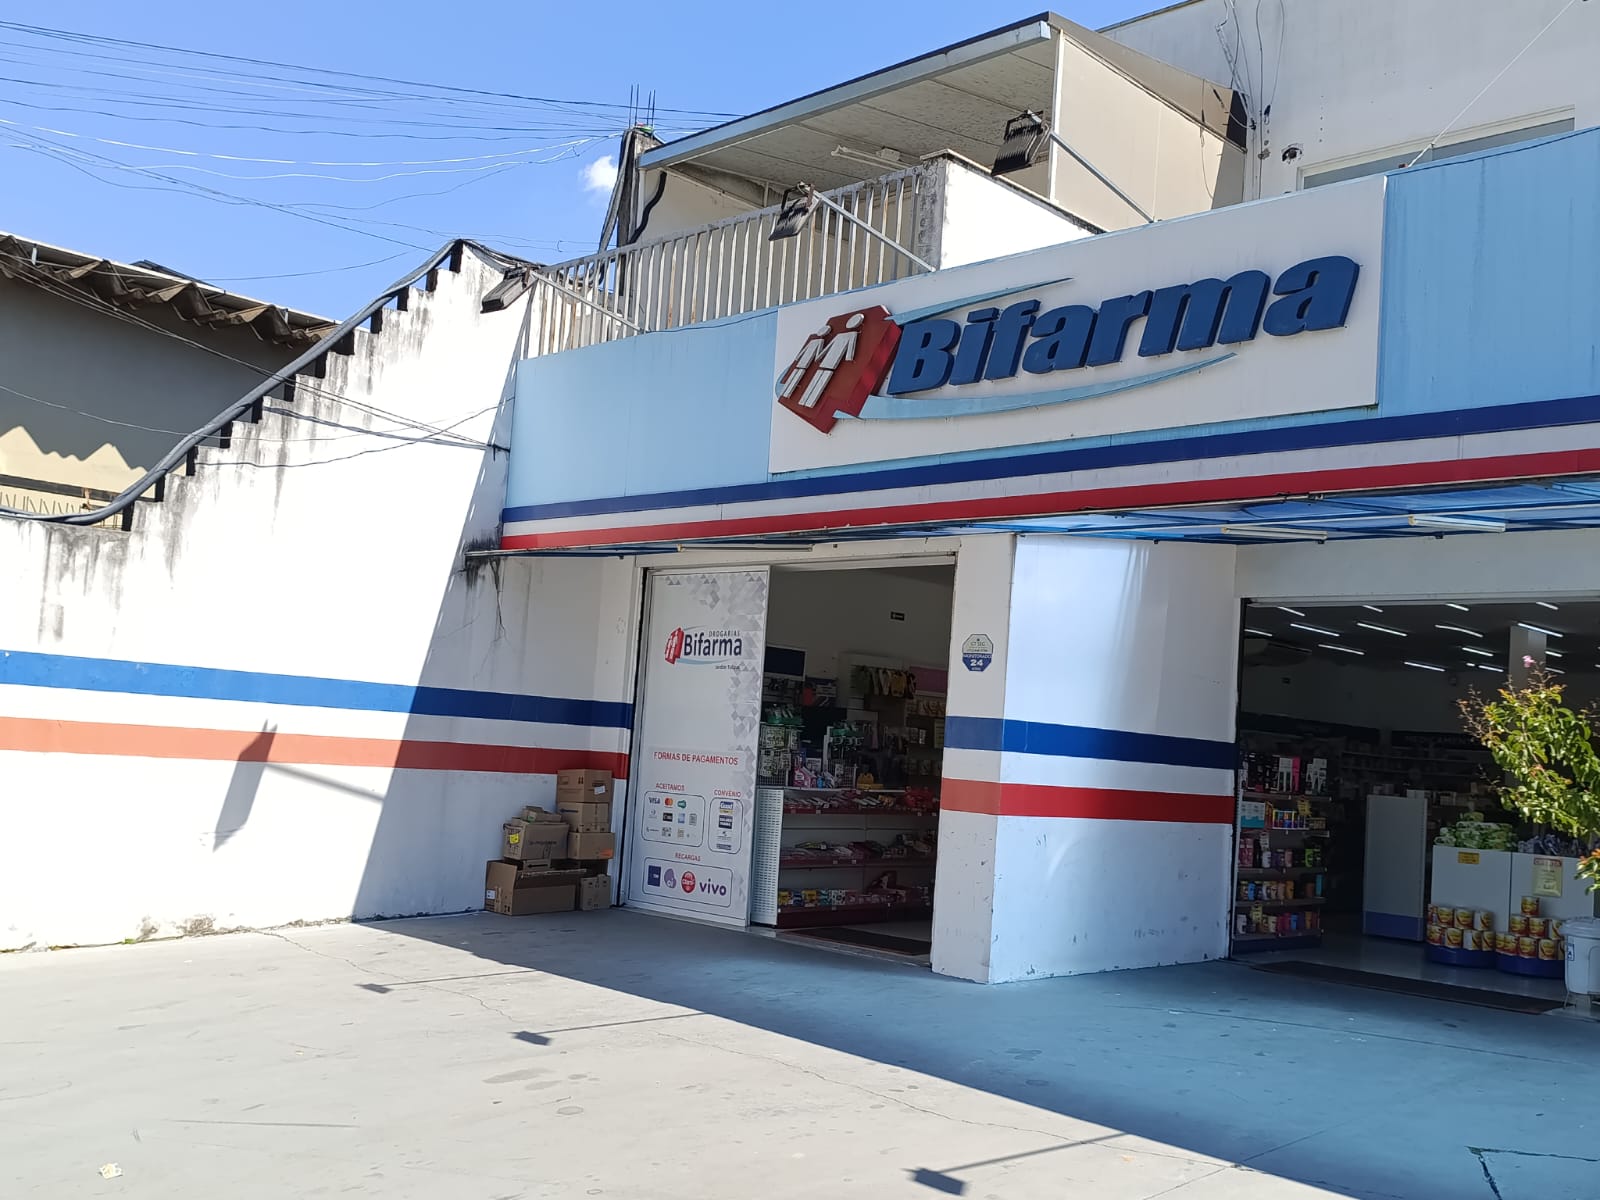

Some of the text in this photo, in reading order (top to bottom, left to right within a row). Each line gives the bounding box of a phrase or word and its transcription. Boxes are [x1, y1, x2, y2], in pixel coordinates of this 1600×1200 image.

[887, 255, 1361, 395] Bifarma
[708, 630, 740, 638] DROGARIAS
[683, 632, 742, 656] Bifarma
[970, 659, 982, 667] 24
[653, 751, 739, 766] FORMAS DE PAGAMENTOS
[655, 782, 685, 791] ACEITAMOS
[648, 796, 661, 804] VISA
[675, 852, 701, 862] RECARGAS
[699, 877, 727, 896] vivo
